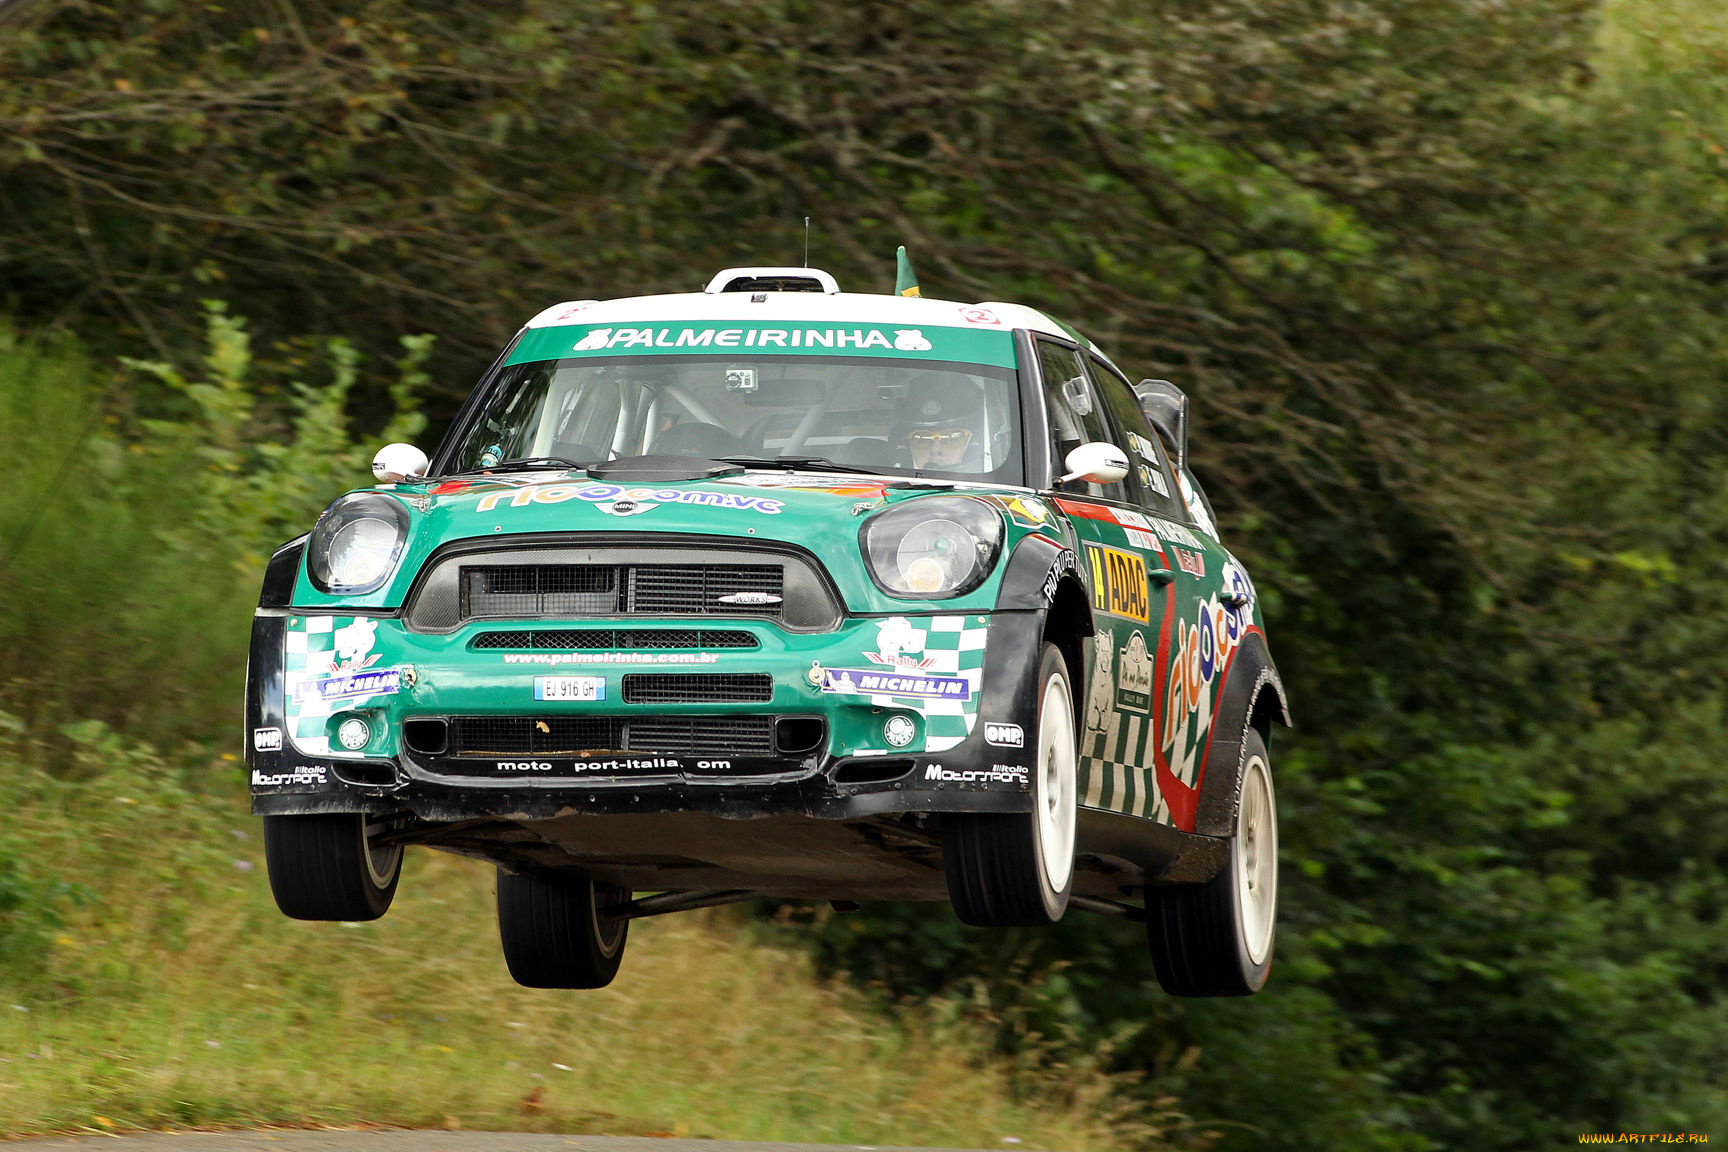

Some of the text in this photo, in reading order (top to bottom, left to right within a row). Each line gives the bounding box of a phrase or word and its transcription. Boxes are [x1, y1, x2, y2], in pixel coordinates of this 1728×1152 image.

[609, 328, 894, 348] PALMEIRINHA
[1109, 552, 1147, 619] ADAC
[340, 659, 362, 671] Rally
[503, 652, 721, 666] www.palmeirinha.com.br
[887, 654, 919, 669] Rally
[323, 673, 400, 696] MICHELIN
[546, 680, 595, 697] EJ 916 GH
[859, 675, 963, 695] MICHELIN
[251, 769, 328, 786] Motorsport
[924, 764, 1029, 784] Motorsport
